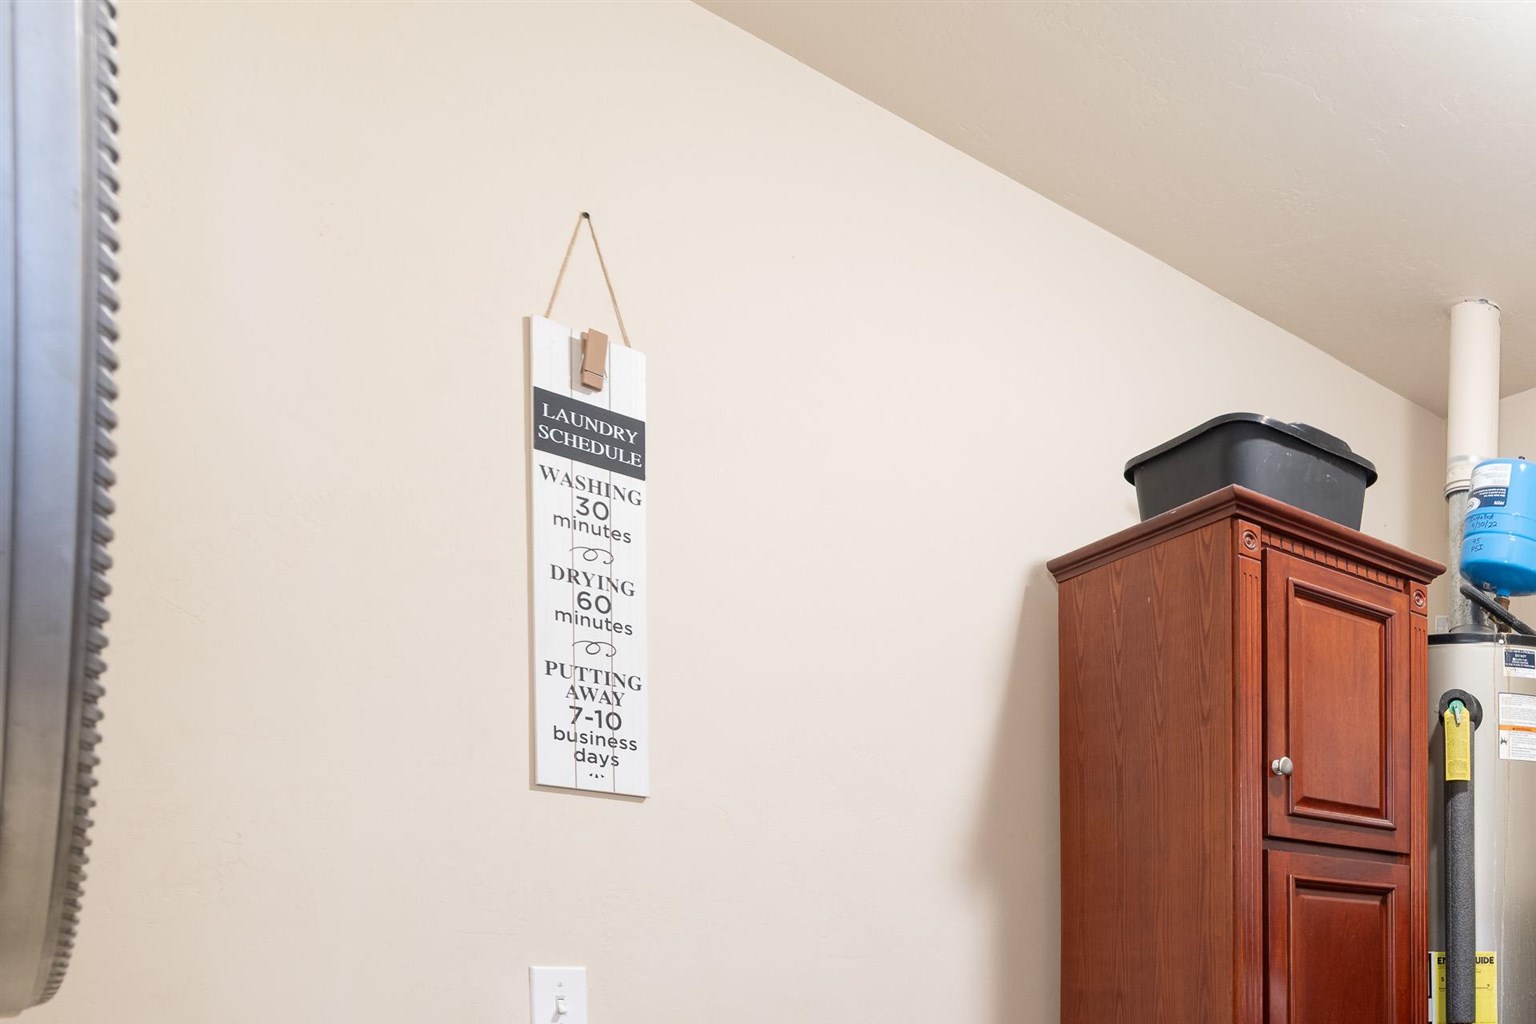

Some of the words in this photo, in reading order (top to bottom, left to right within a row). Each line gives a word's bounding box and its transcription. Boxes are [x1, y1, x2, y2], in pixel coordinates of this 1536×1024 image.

[542, 402, 639, 445] LAUNDRY
[537, 424, 643, 469] SCHEDULE
[539, 463, 643, 507] WASHING
[575, 495, 610, 522] 30
[553, 513, 632, 544] minutes
[550, 563, 635, 598] DRYING
[576, 590, 612, 616] 60
[554, 608, 634, 637] minutes
[544, 659, 643, 692] PUTTING
[565, 683, 625, 707] AWAY
[568, 704, 622, 732] 7-10
[553, 725, 638, 752] business
[573, 747, 620, 768] days
